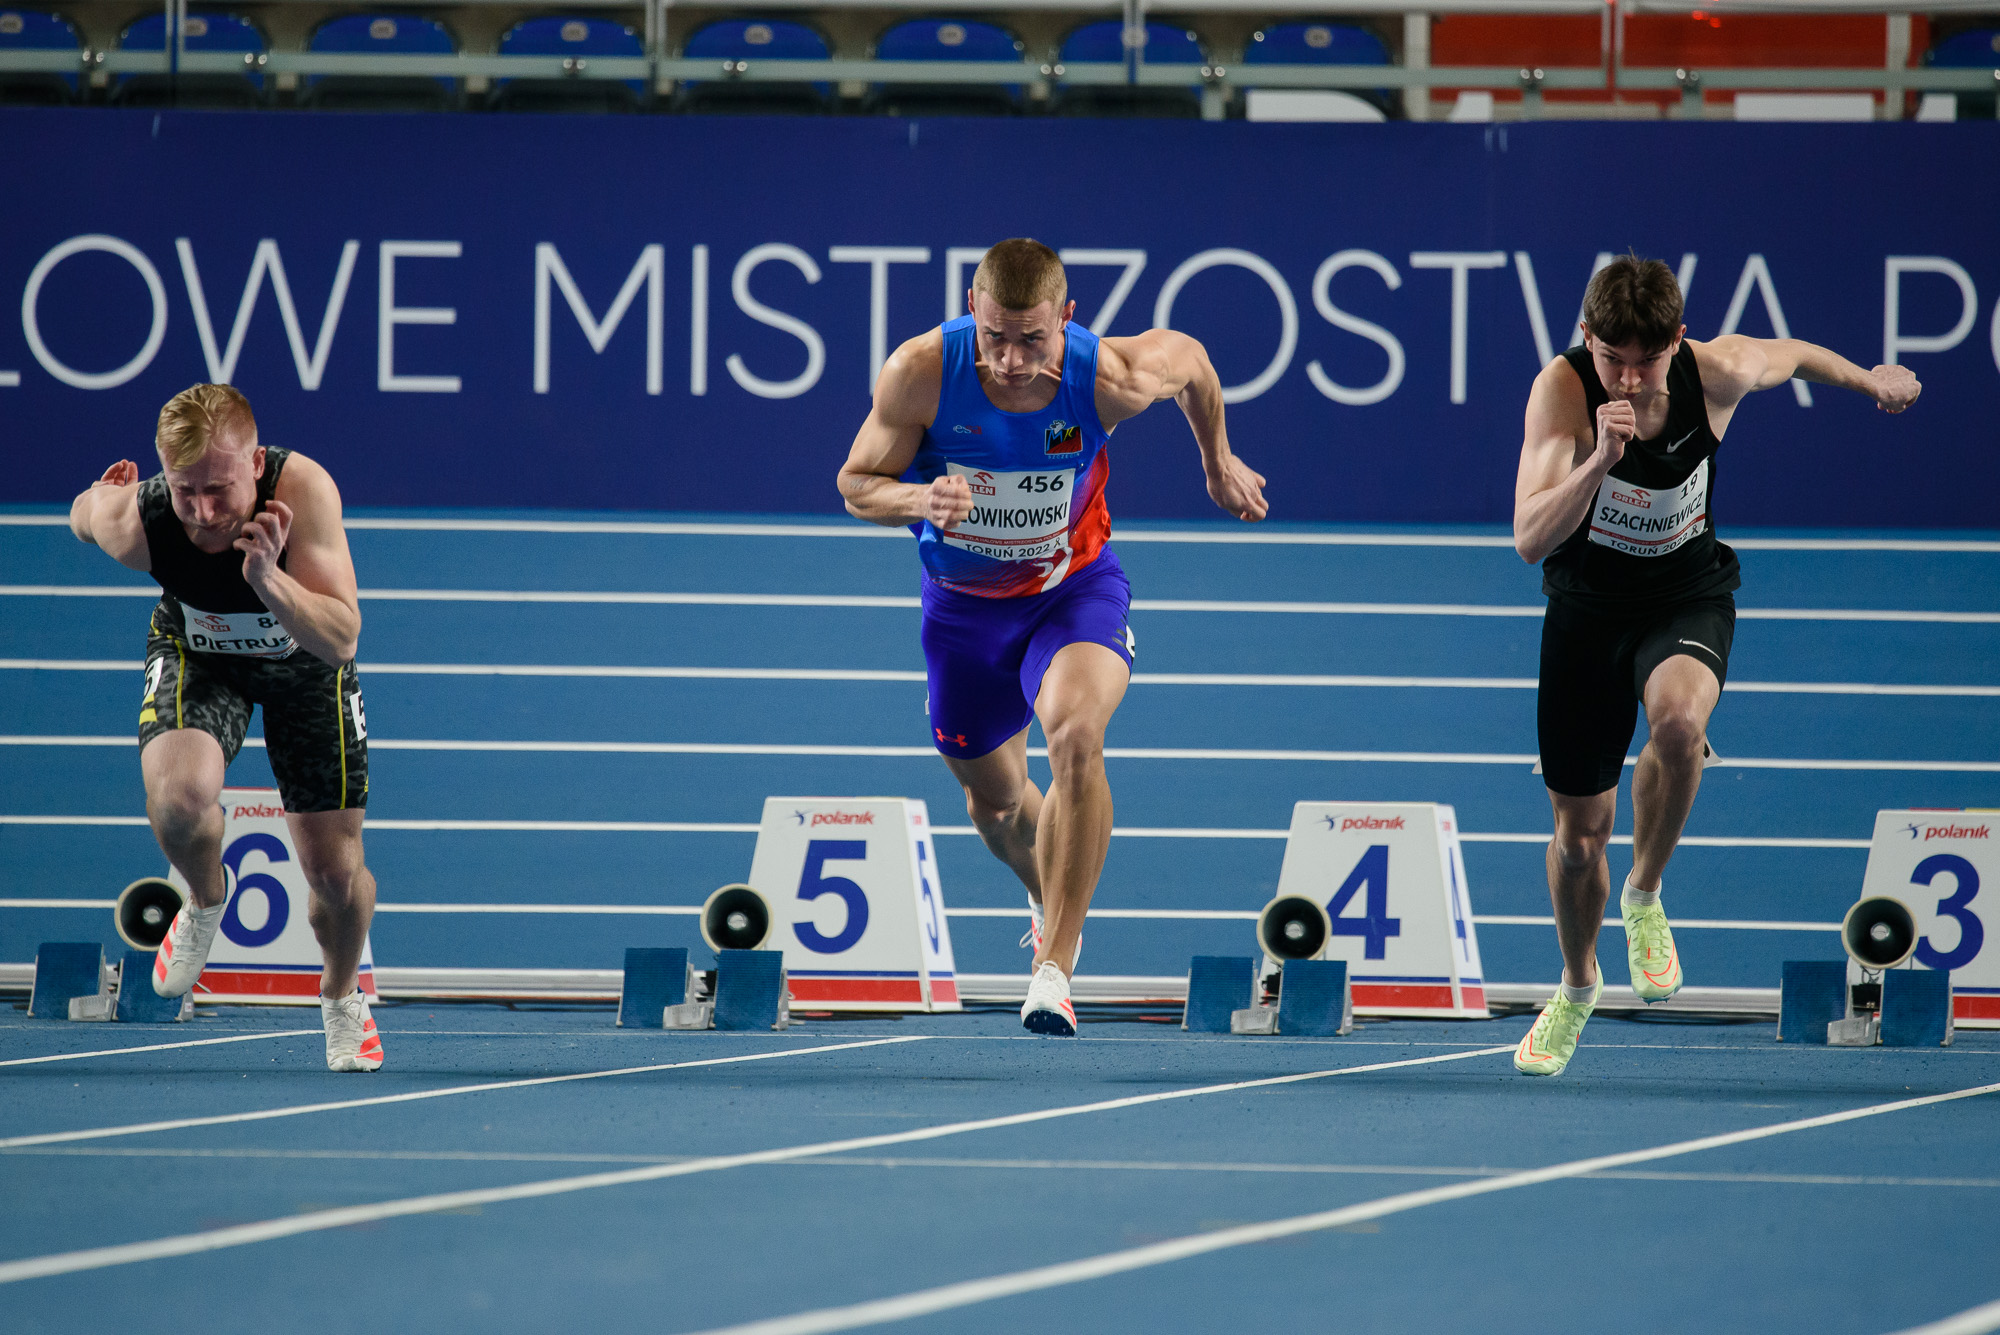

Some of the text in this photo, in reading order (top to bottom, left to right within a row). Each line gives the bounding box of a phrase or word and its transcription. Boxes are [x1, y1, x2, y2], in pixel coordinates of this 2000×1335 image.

[0, 234, 462, 392] OWE
[1884, 255, 2000, 374] P
[968, 485, 994, 495] RLEN
[1018, 475, 1064, 493] 456
[1680, 473, 1698, 500] 19
[1613, 492, 1651, 509] ORLEN
[961, 501, 1068, 529] OWIKOWSKI
[1600, 492, 1703, 532] SZACHNIEWICZ
[965, 543, 1050, 558] TORUŃ 2022
[1611, 540, 1658, 555] TORUŃ
[1662, 533, 1688, 553] 2022
[258, 617, 279, 628] 8
[233, 803, 285, 820] polani
[811, 811, 875, 827] polanik
[1340, 816, 1406, 832] polanik
[1924, 825, 1990, 841] polanik
[220, 843, 290, 948] 6
[793, 840, 869, 954] 5
[1325, 845, 1401, 960] 4
[1910, 853, 1984, 970] 3
